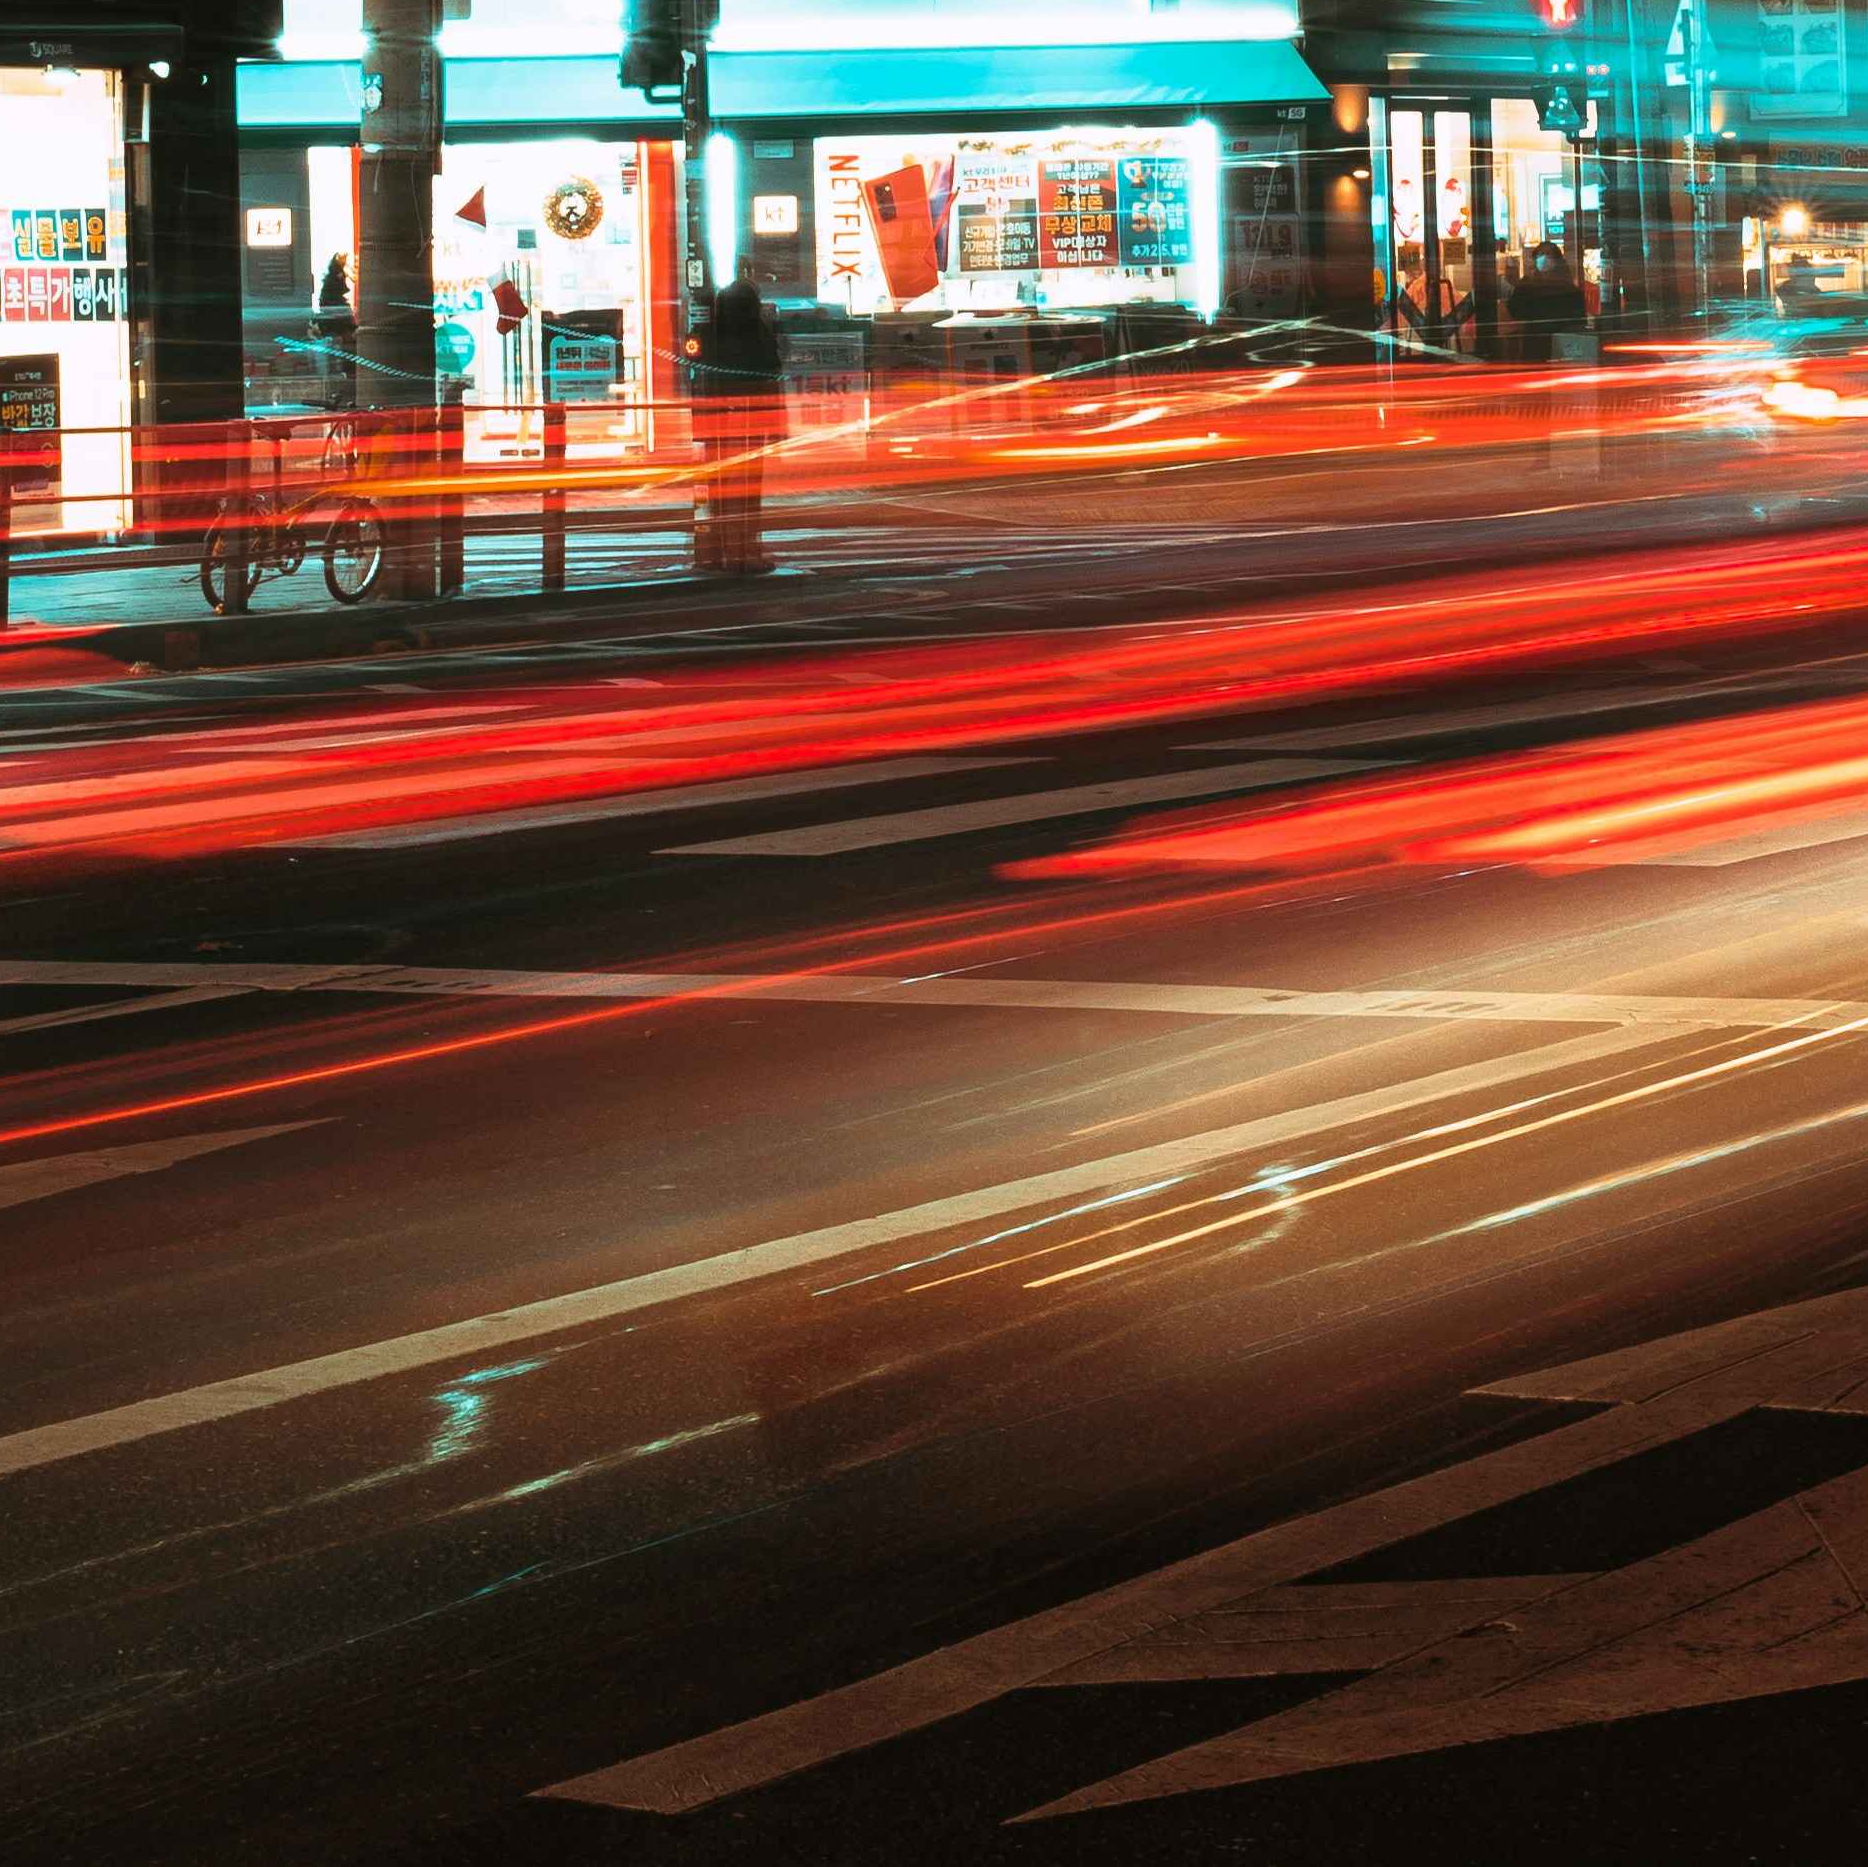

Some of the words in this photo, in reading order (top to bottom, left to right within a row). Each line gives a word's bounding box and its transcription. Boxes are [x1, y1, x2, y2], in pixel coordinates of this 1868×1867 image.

[44, 43, 74, 57] SQUARE
[765, 204, 786, 223] kt
[828, 154, 861, 276] NETFLIX
